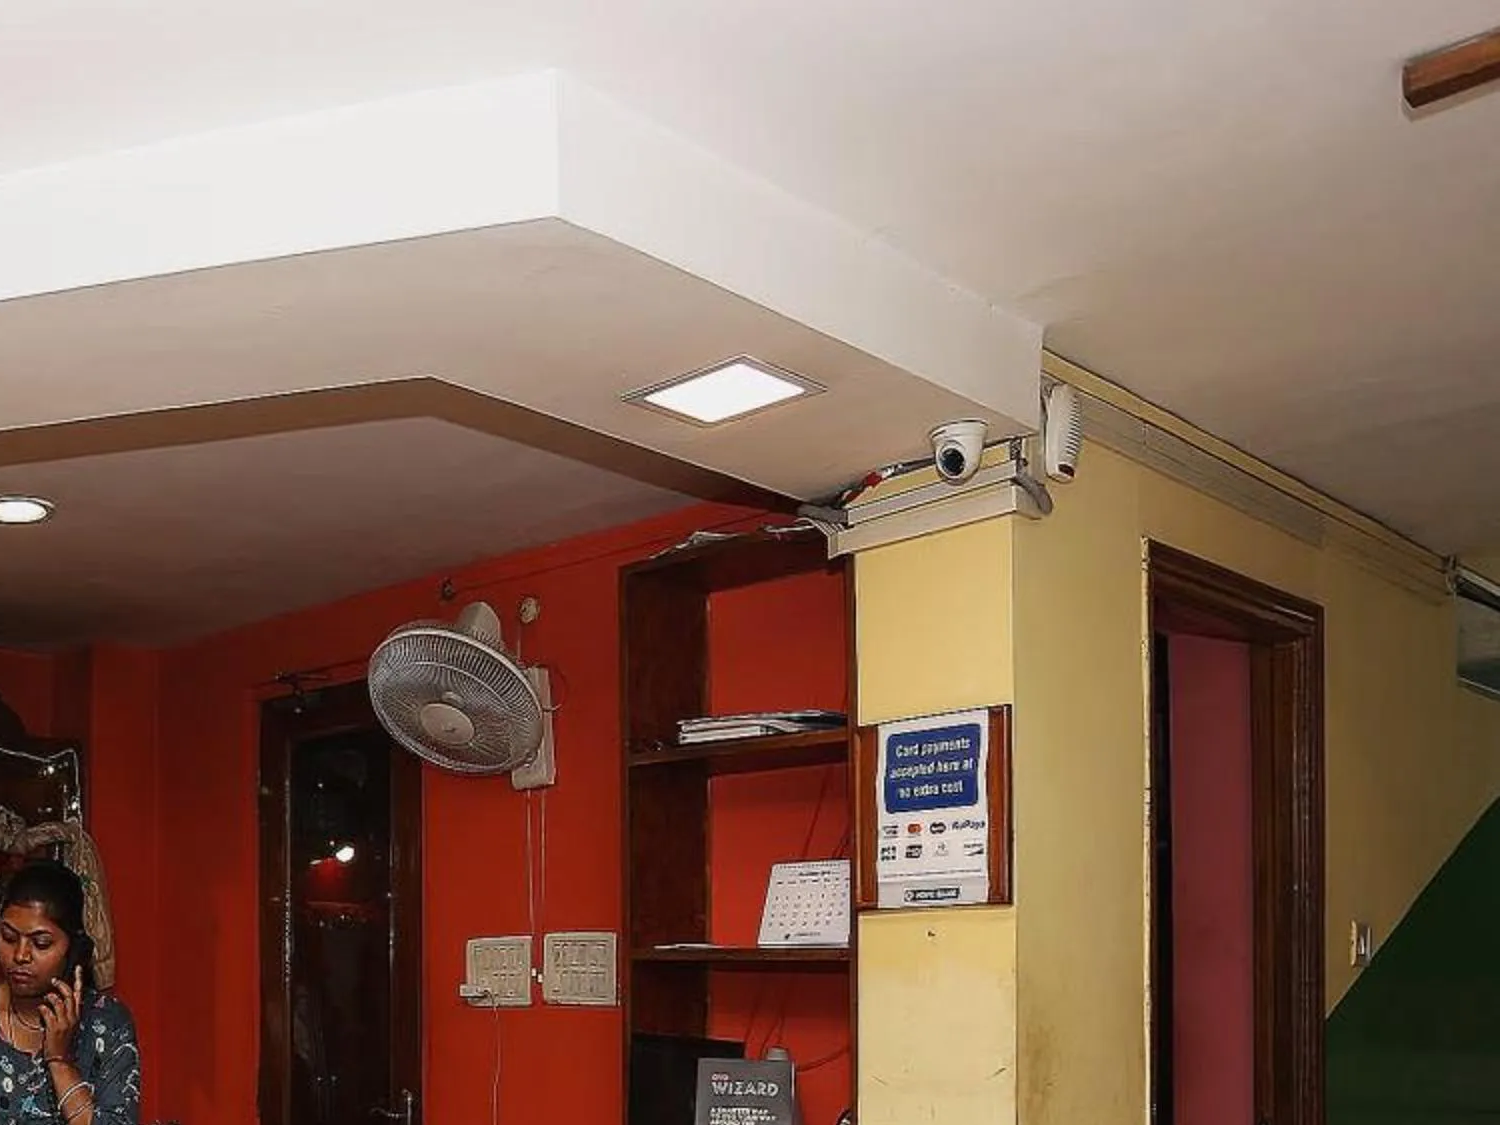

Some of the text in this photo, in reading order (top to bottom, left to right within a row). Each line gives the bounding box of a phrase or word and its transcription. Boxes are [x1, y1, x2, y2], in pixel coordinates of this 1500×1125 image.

[896, 737, 971, 757] Card payments
[936, 760, 960, 773] here
[913, 784, 939, 797] extra
[711, 1081, 779, 1097] WIZARD
